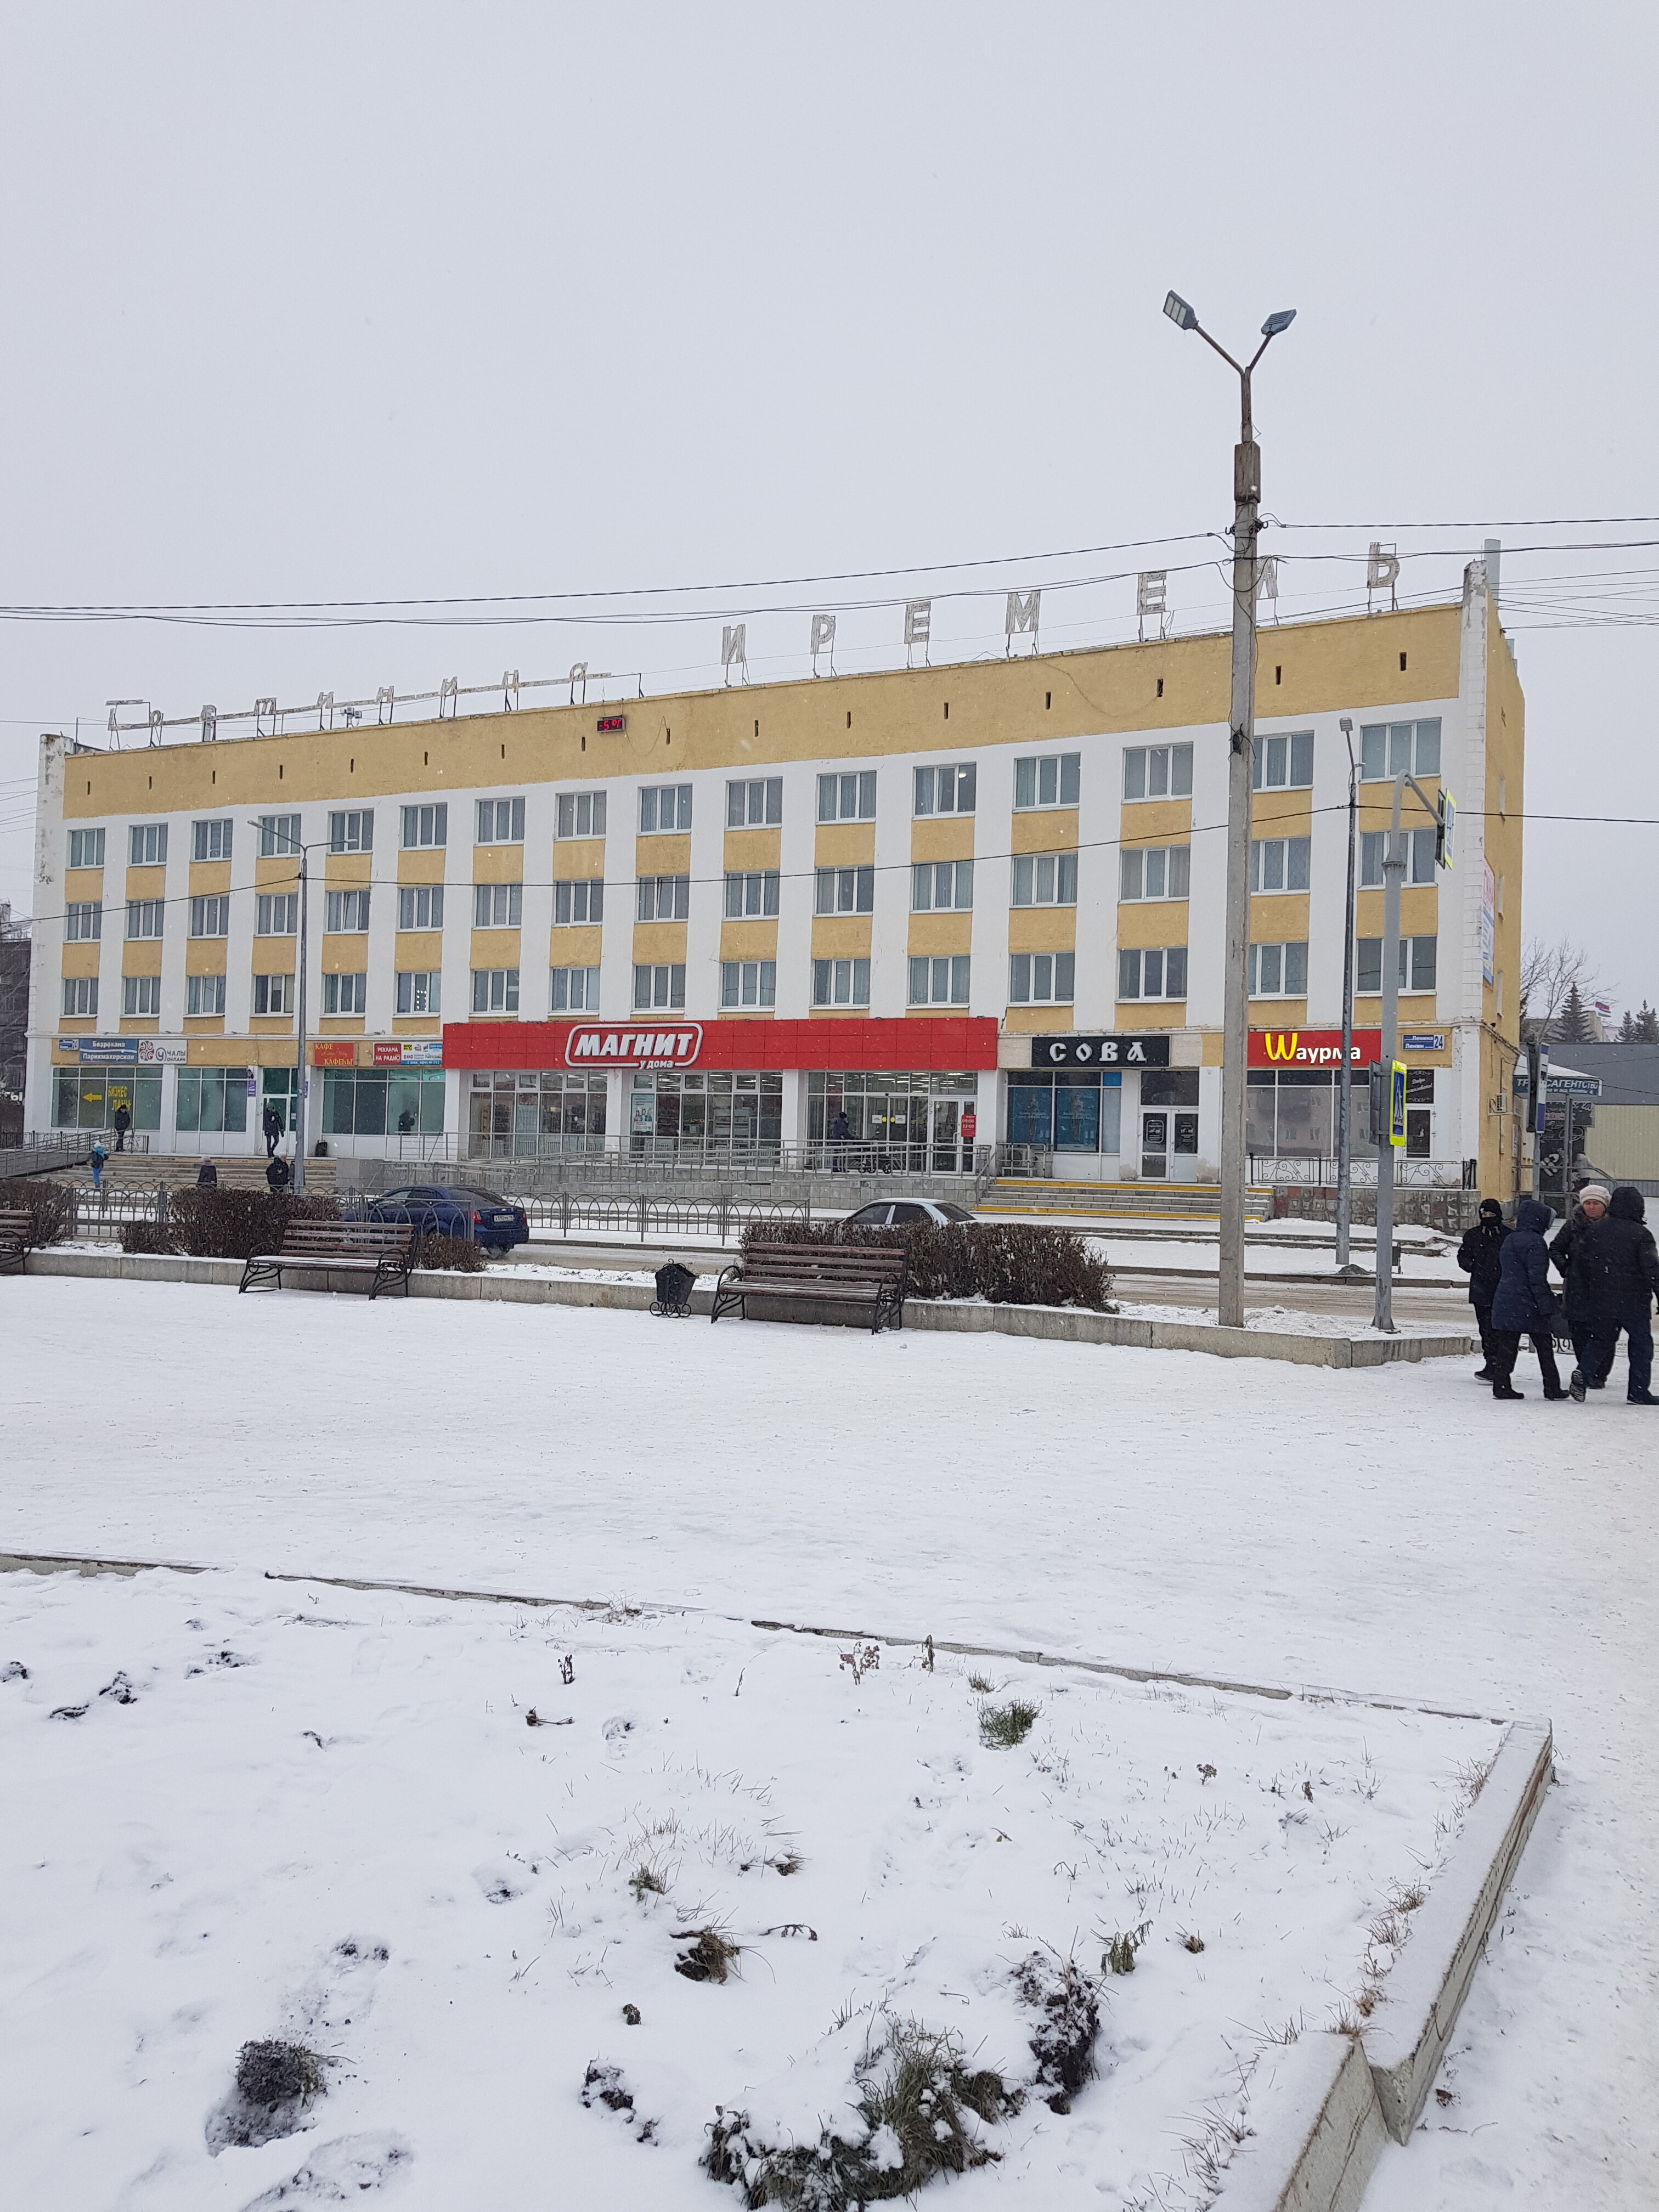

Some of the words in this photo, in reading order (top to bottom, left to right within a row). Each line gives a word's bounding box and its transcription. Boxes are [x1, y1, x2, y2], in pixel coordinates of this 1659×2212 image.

[721, 541, 1401, 666] ИРЕМЕЛЬ
[574, 1034, 693, 1057] МАГНИТ
[1434, 1035, 1443, 1049] 24
[82, 1053, 134, 1061] Парикмахерская
[1048, 1041, 1147, 1062] СОВА
[639, 1060, 647, 1070] у
[646, 1059, 674, 1069] дома
